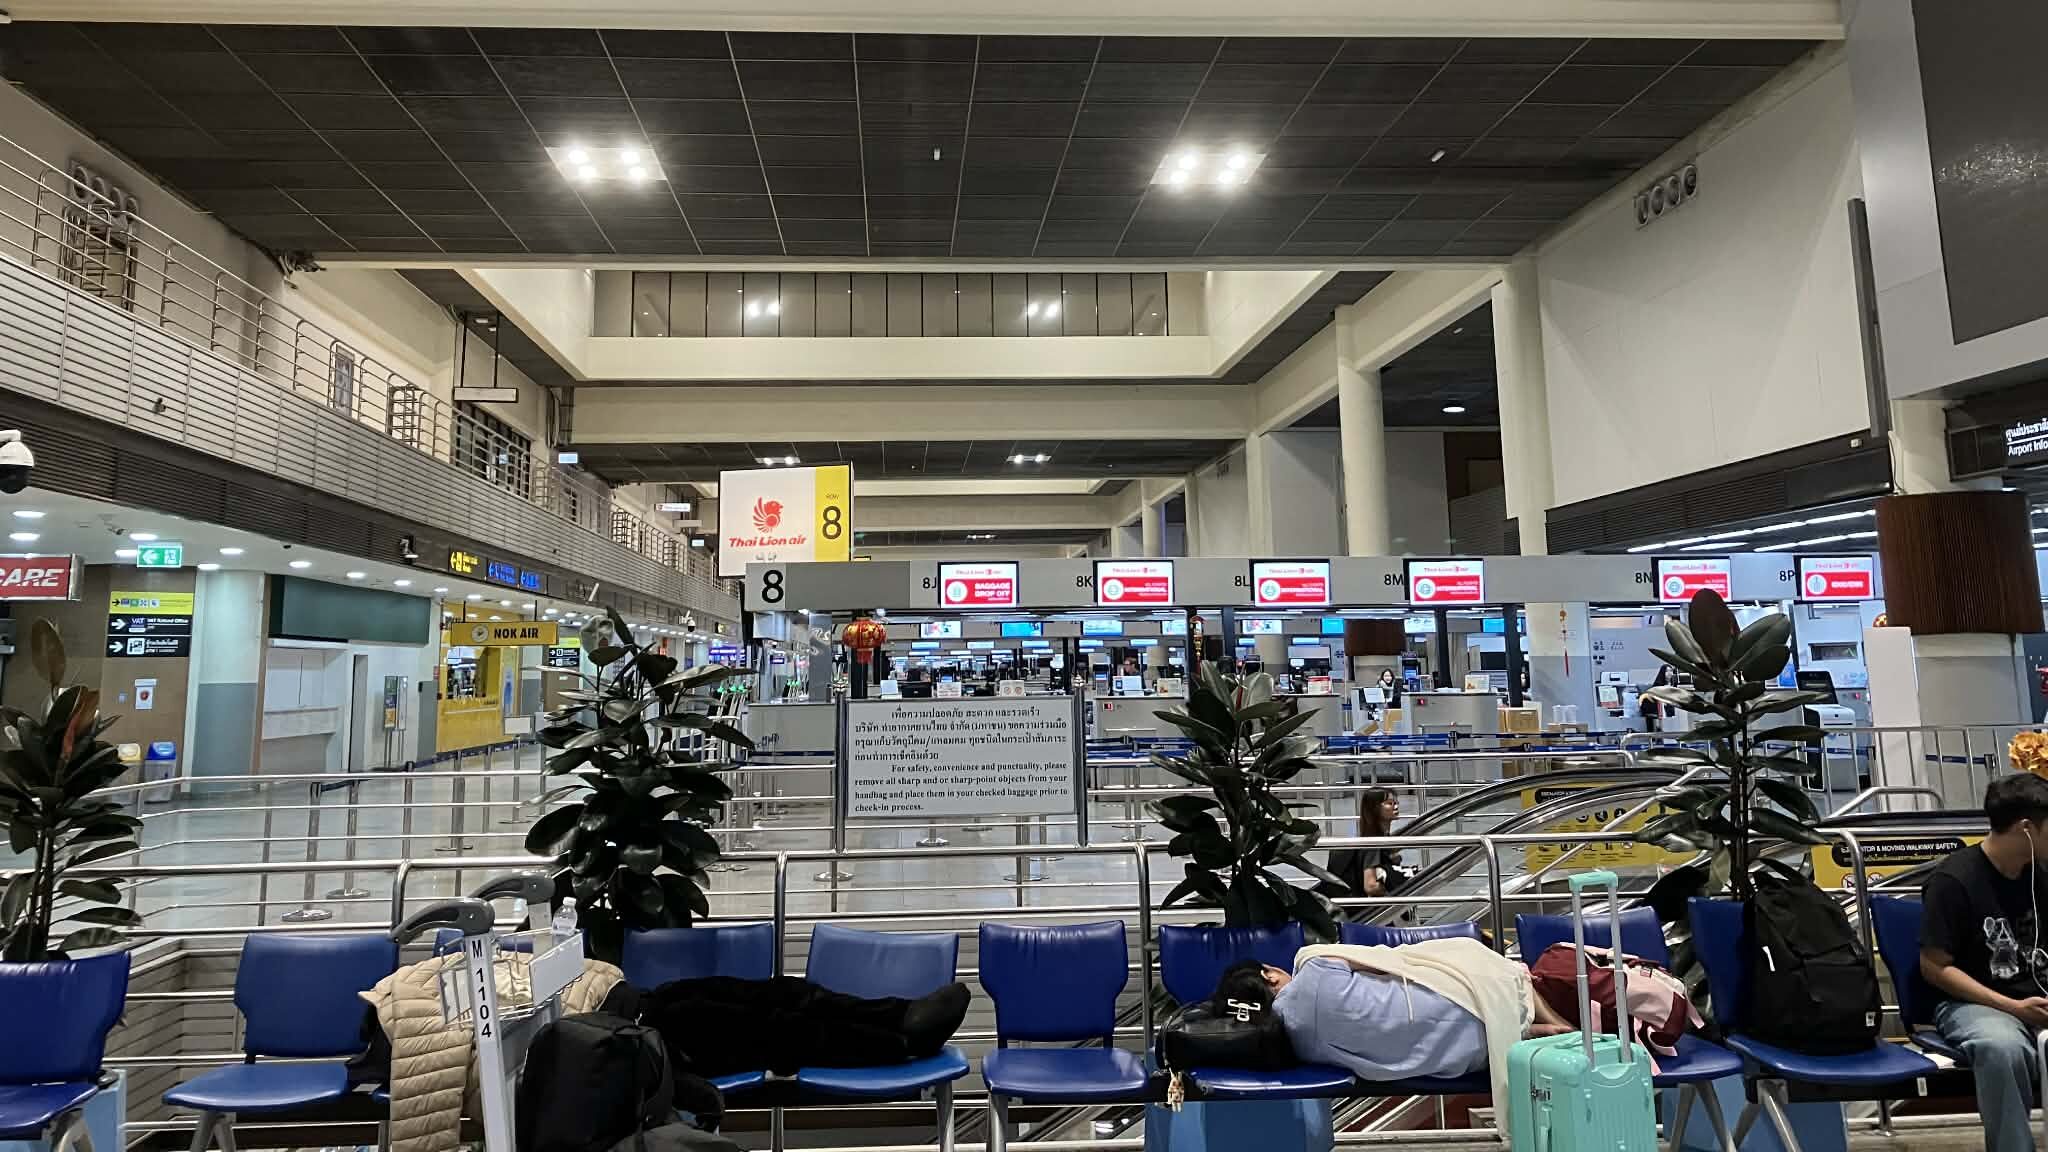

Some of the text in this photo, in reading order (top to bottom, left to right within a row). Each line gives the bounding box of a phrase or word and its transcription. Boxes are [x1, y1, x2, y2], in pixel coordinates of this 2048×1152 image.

[2008, 442, 2033, 456] Airport
[822, 505, 841, 539] 8
[729, 535, 807, 547] Thai Lion air
[1076, 575, 1093, 587] 8K
[1234, 575, 1250, 587] 8L
[1384, 574, 1404, 586] 8M
[1780, 570, 1795, 581] 8P
[761, 569, 784, 603] 8
[922, 577, 937, 589] 8J
[131, 617, 145, 625] VAT
[494, 627, 539, 639] NOK AIR
[892, 762, 1067, 773] For safety, convenience and punctuality, please
[886, 777, 896, 785] all
[898, 777, 921, 787] sharp
[923, 776, 938, 785] and
[950, 775, 997, 786] sharp-point
[998, 774, 1026, 784] objects
[1049, 775, 1068, 783] your
[855, 788, 1068, 800] handbag and place them in your checked baggage prior to
[855, 803, 924, 813] check-in process.
[1935, 842, 1958, 850] SAFETY
[472, 940, 483, 958] M
